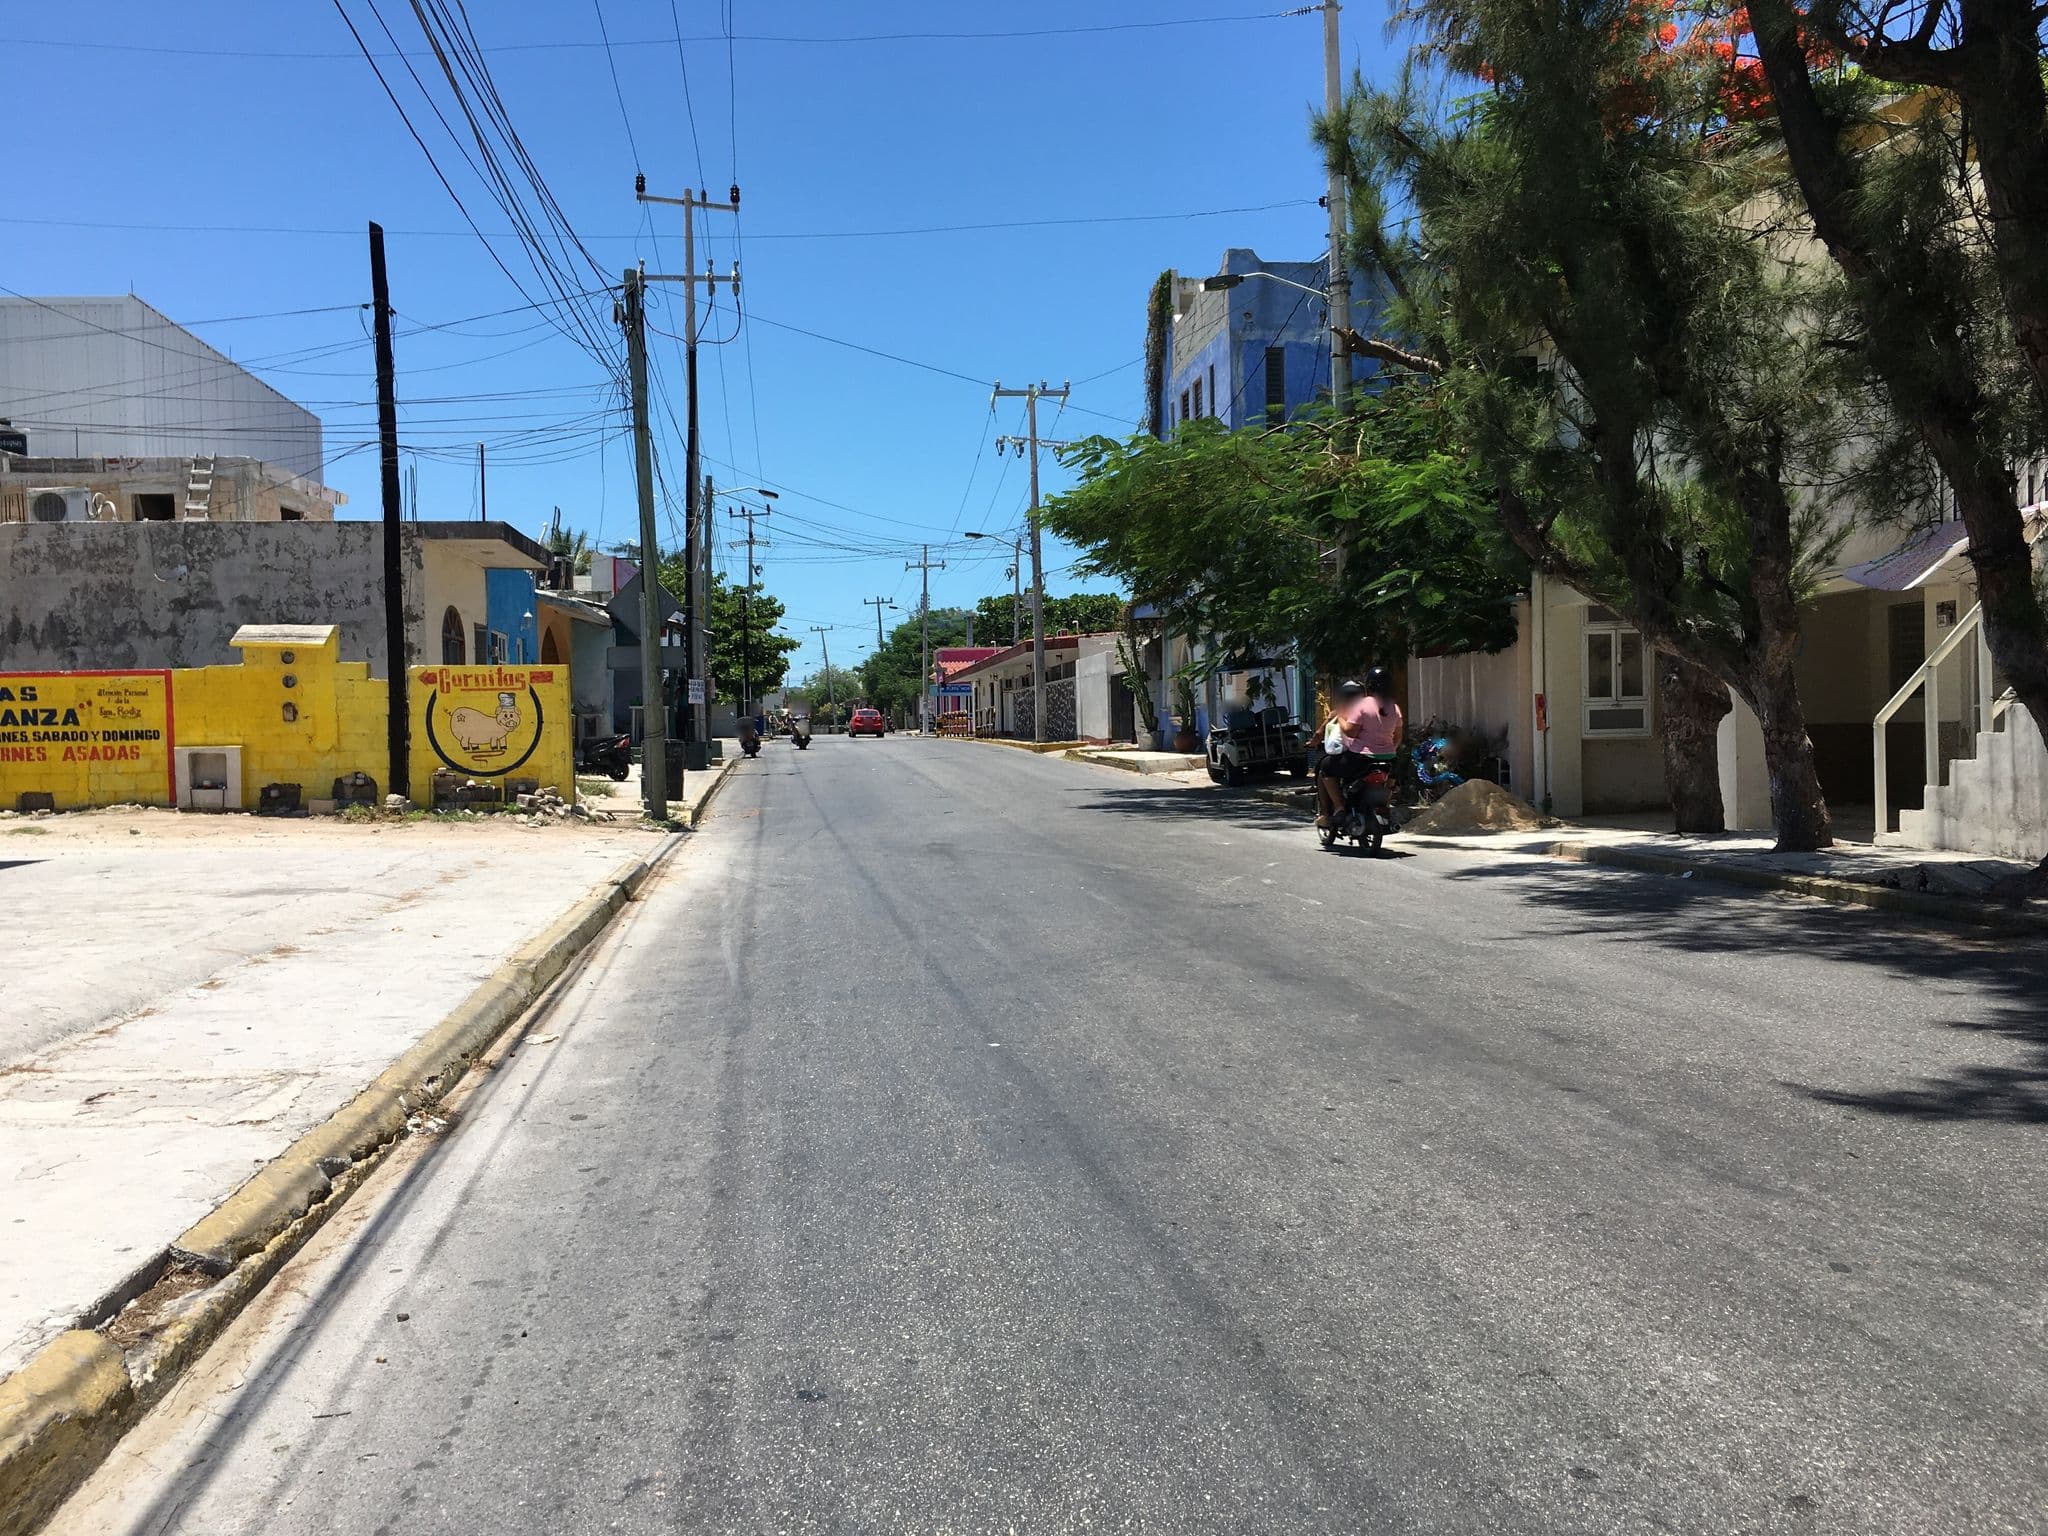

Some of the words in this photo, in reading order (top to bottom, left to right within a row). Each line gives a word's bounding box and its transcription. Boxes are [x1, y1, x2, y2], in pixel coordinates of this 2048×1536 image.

[438, 667, 526, 694] Carnitas
[0, 686, 38, 702] AS
[0, 708, 80, 726] ANZA
[33, 731, 88, 743] SABADO
[90, 731, 99, 742] Y
[102, 730, 160, 742] DOMINGO
[62, 745, 140, 762] ASADAS
